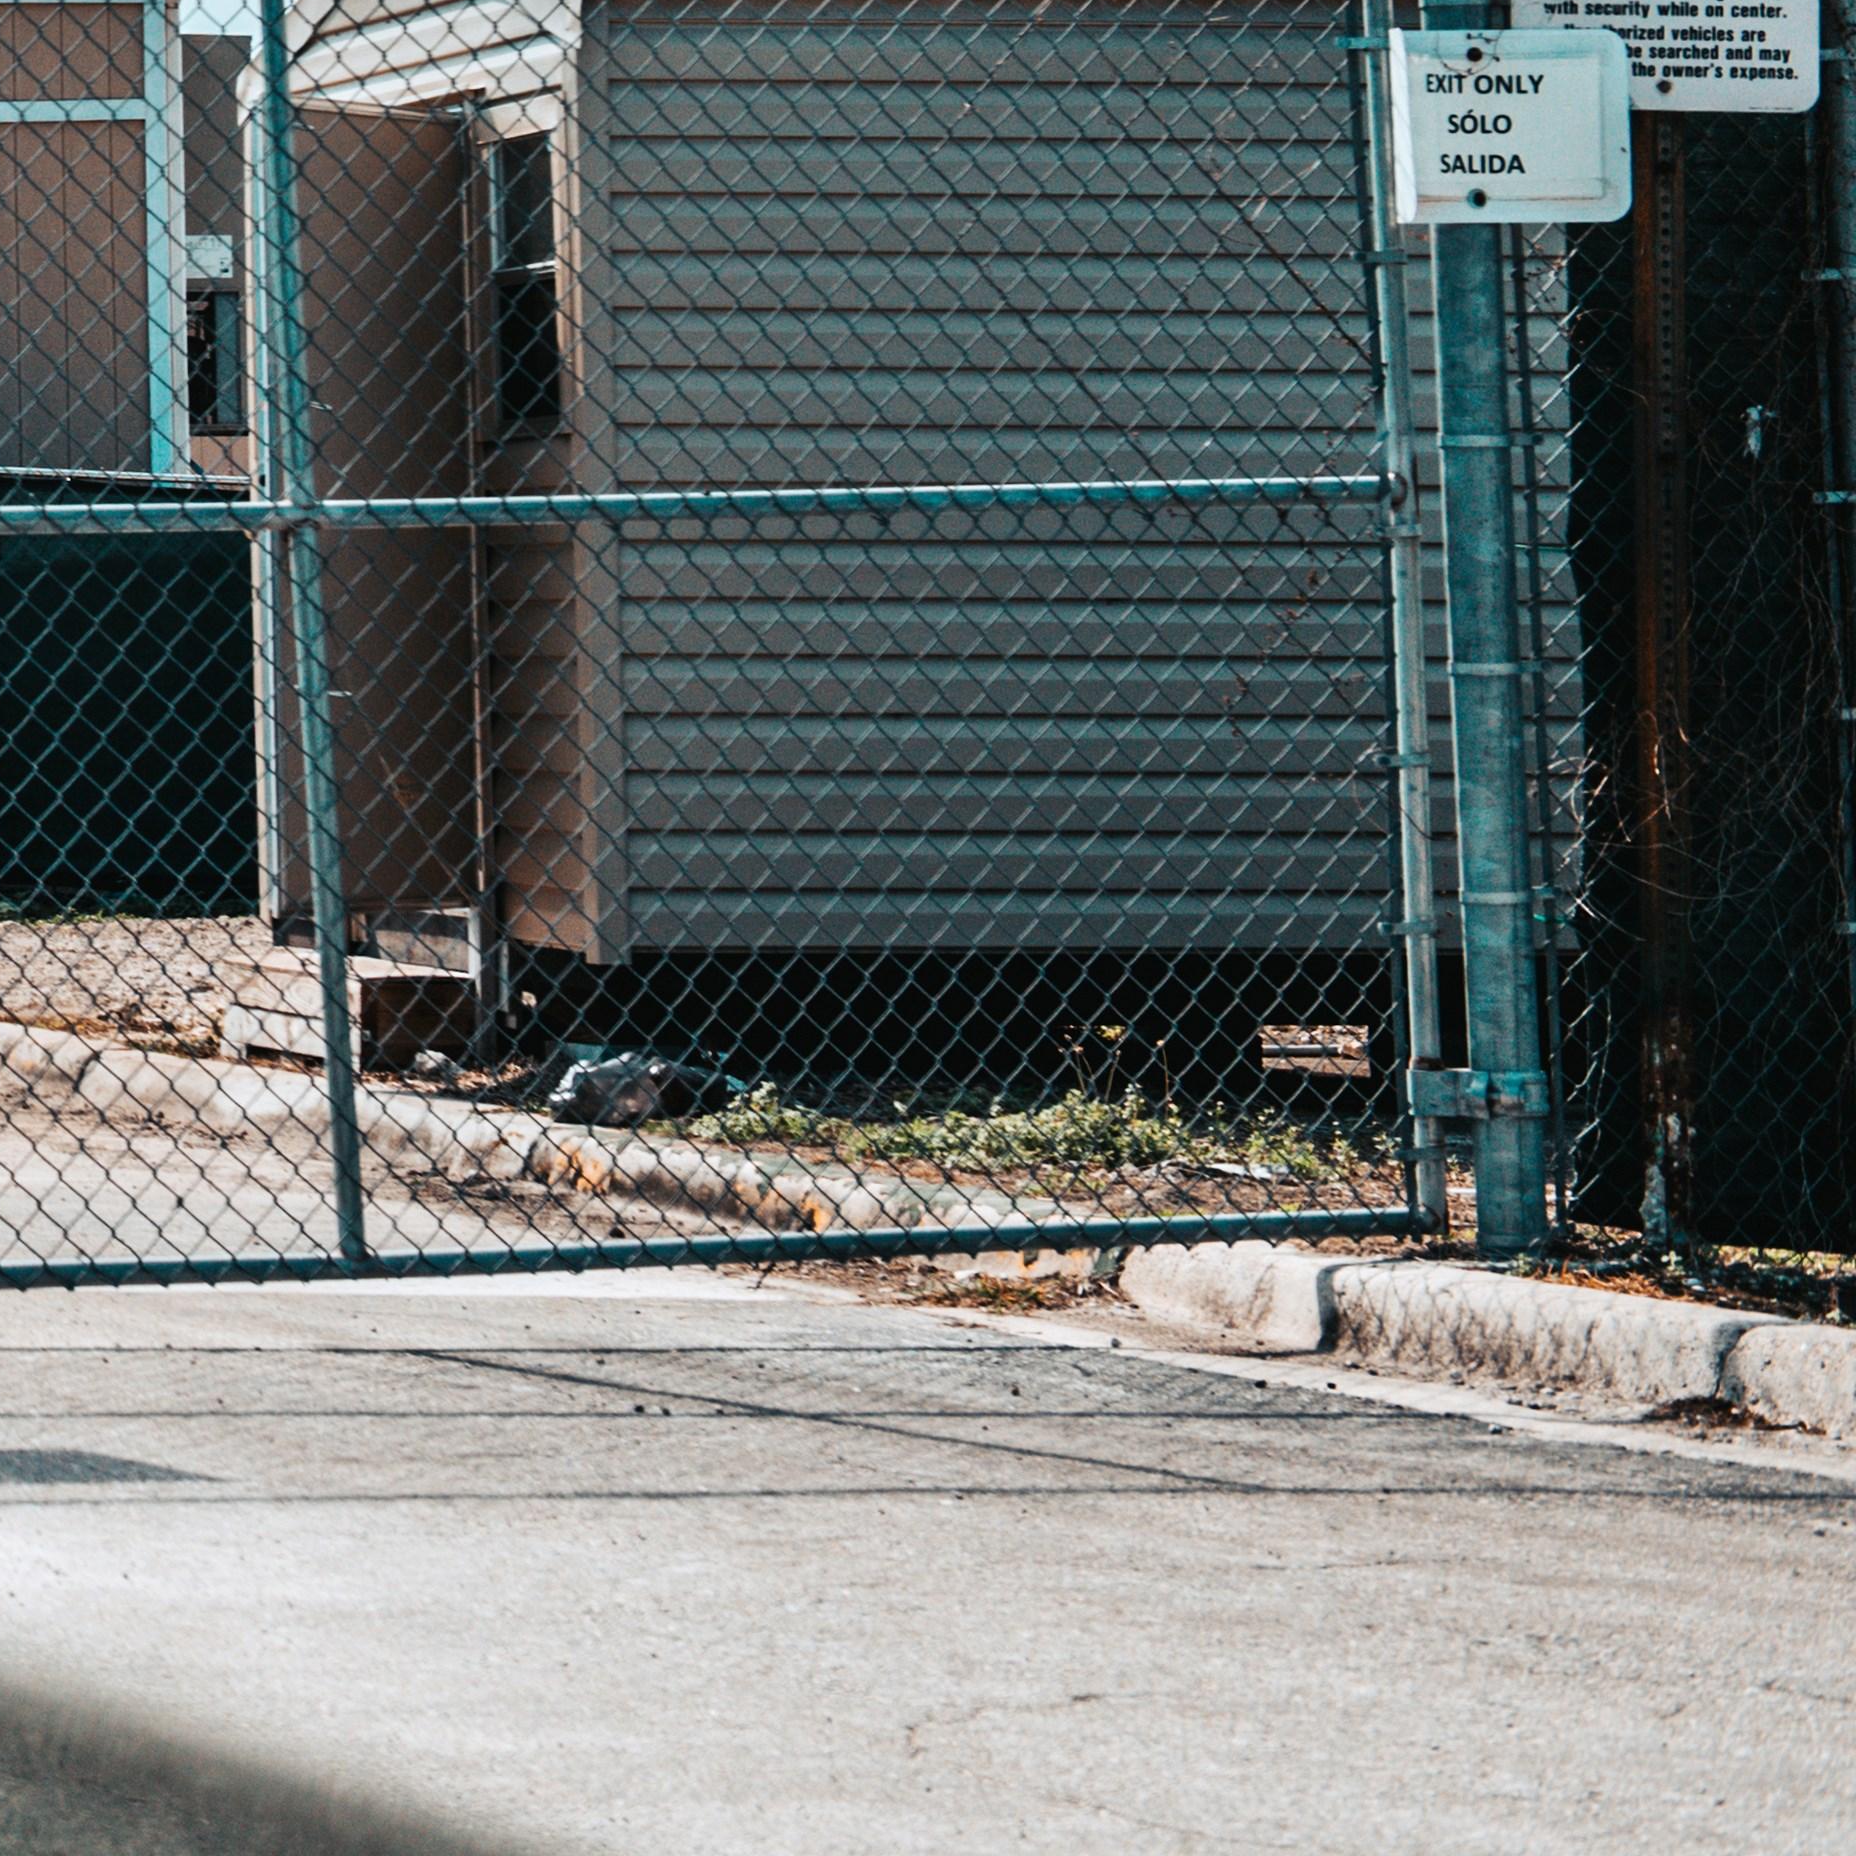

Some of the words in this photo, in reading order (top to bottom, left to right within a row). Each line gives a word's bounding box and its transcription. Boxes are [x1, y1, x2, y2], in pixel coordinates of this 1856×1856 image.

[1544, 0, 1578, 15] with
[1585, 1, 1650, 19] security
[1657, 1, 1699, 16] while
[1705, 5, 1724, 17] on
[1731, 3, 1787, 18] center.
[1671, 25, 1734, 41] vehicles
[1741, 30, 1766, 42] are
[1648, 45, 1719, 59] searched
[1725, 46, 1753, 60] and
[1759, 49, 1791, 64] may
[1632, 62, 1656, 77] the
[1662, 63, 1724, 78] owner's
[1729, 66, 1798, 81] expense.
[1426, 73, 1465, 93] EXIT
[1474, 75, 1544, 94] ONLY
[1448, 109, 1512, 134] SÓLO
[1440, 154, 1526, 174] SALIDA
